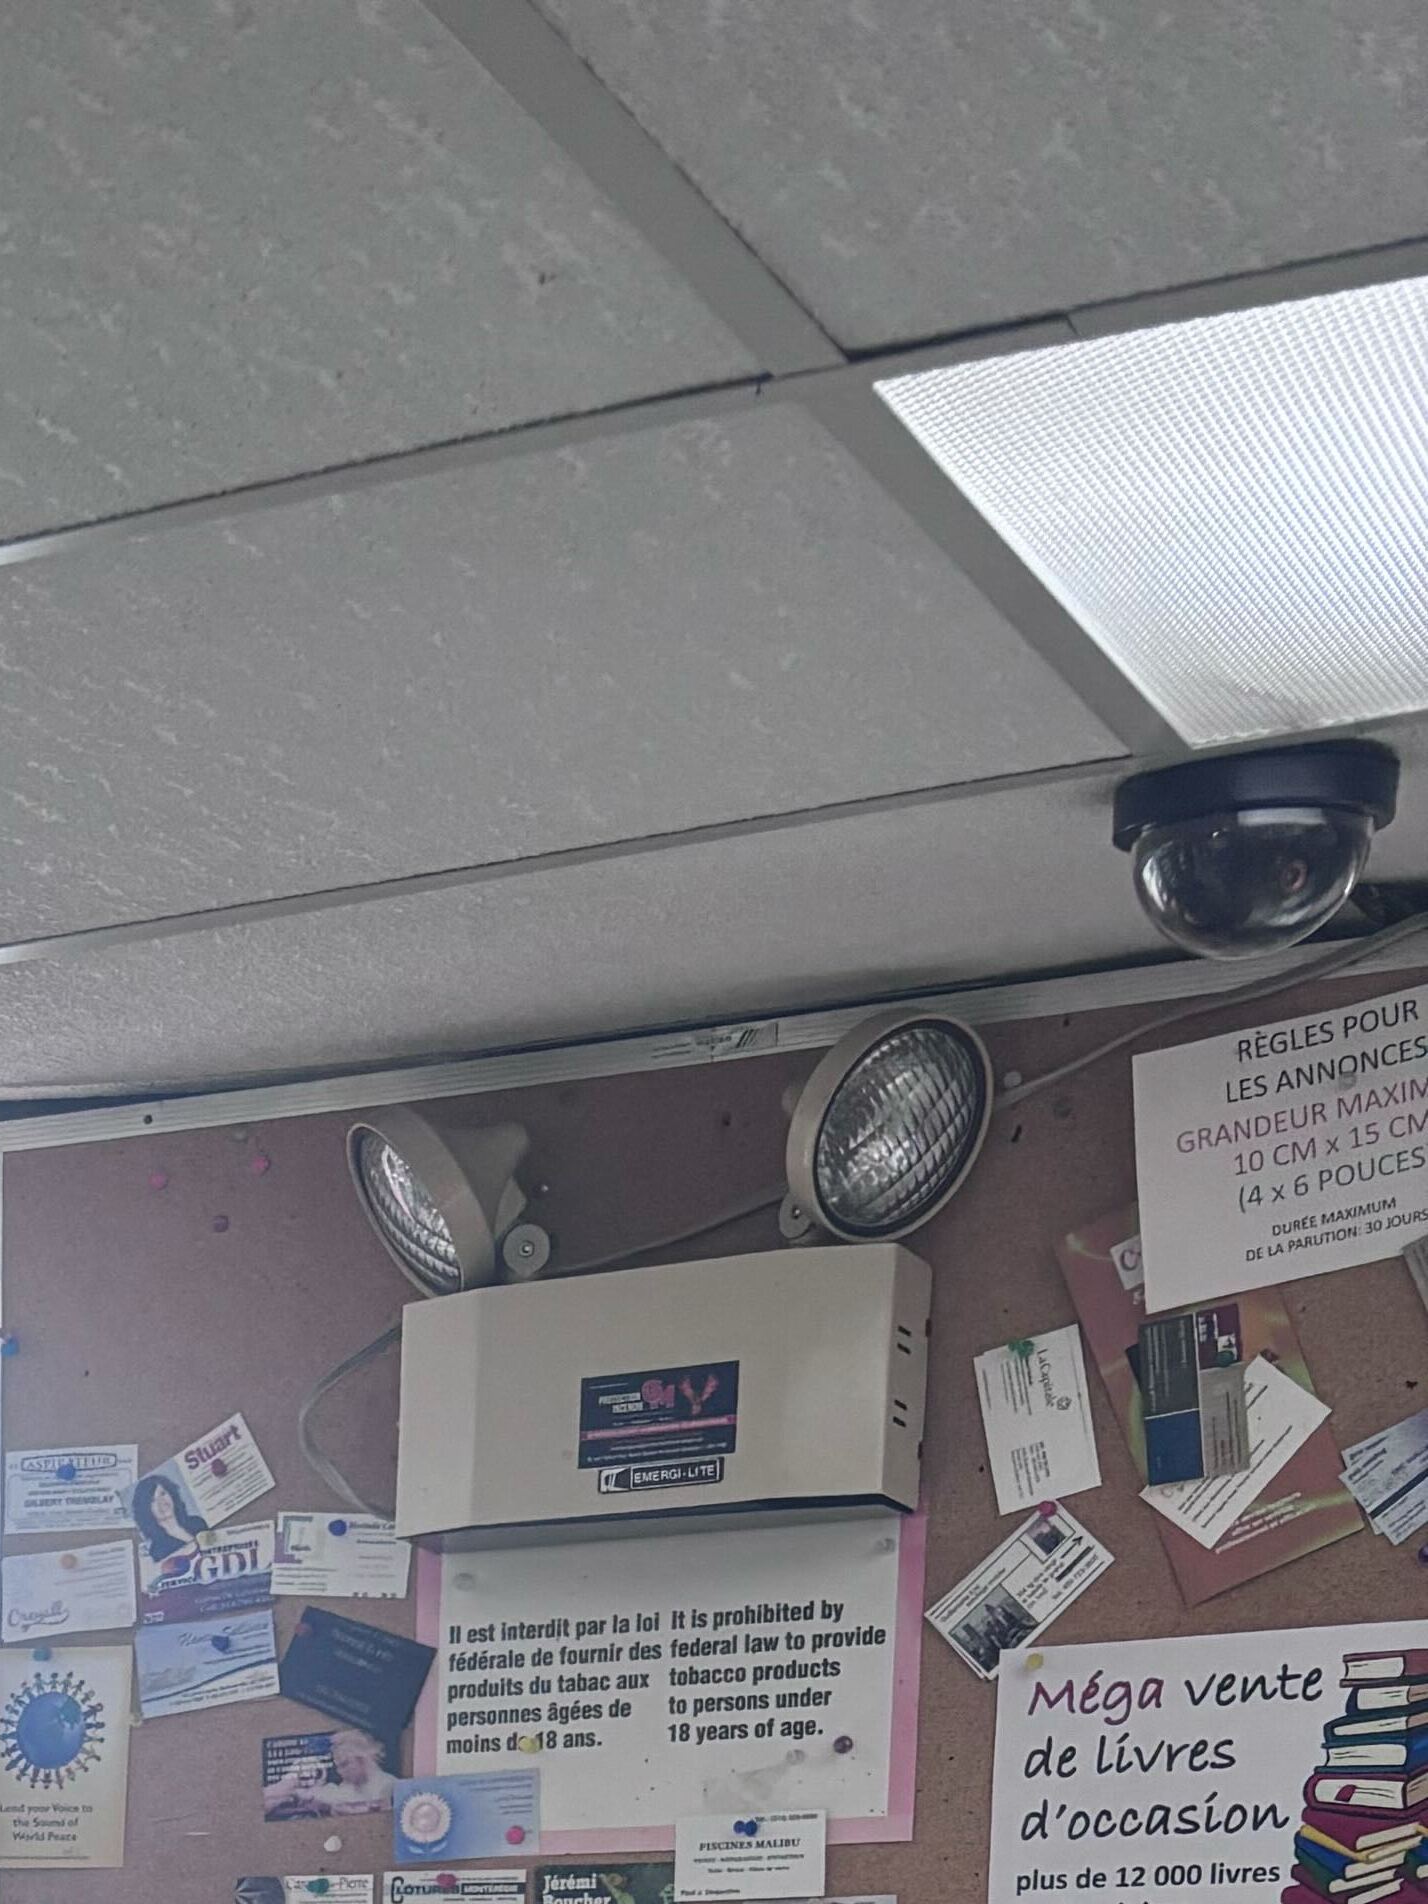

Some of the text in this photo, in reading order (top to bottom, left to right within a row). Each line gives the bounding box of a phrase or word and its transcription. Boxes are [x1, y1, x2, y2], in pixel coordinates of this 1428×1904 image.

[1237, 999, 1419, 1064] RÈGLES POUR
[1226, 1035, 1428, 1104] LES ANNONCES
[1234, 1108, 1428, 1176] 10 CM x 15 CM
[1272, 1197, 1398, 1237] DURÉE MAXIMUM
[671, 1600, 844, 1632] It is prohibited by
[448, 1640, 662, 1672] fédérale de fournir des
[669, 1626, 886, 1660] federal law to provide
[447, 1672, 650, 1704] produits du tabac aux
[669, 1658, 841, 1687] tobacco products
[668, 1688, 832, 1718] to persons under
[1027, 1662, 1324, 1725] Méga vente
[668, 1717, 824, 1747] 18 years of age.
[1020, 1792, 1290, 1842] d'occasion
[543, 1872, 598, 1895] Jérémi
[1016, 1862, 1281, 1896] plus de 12 000 livres
